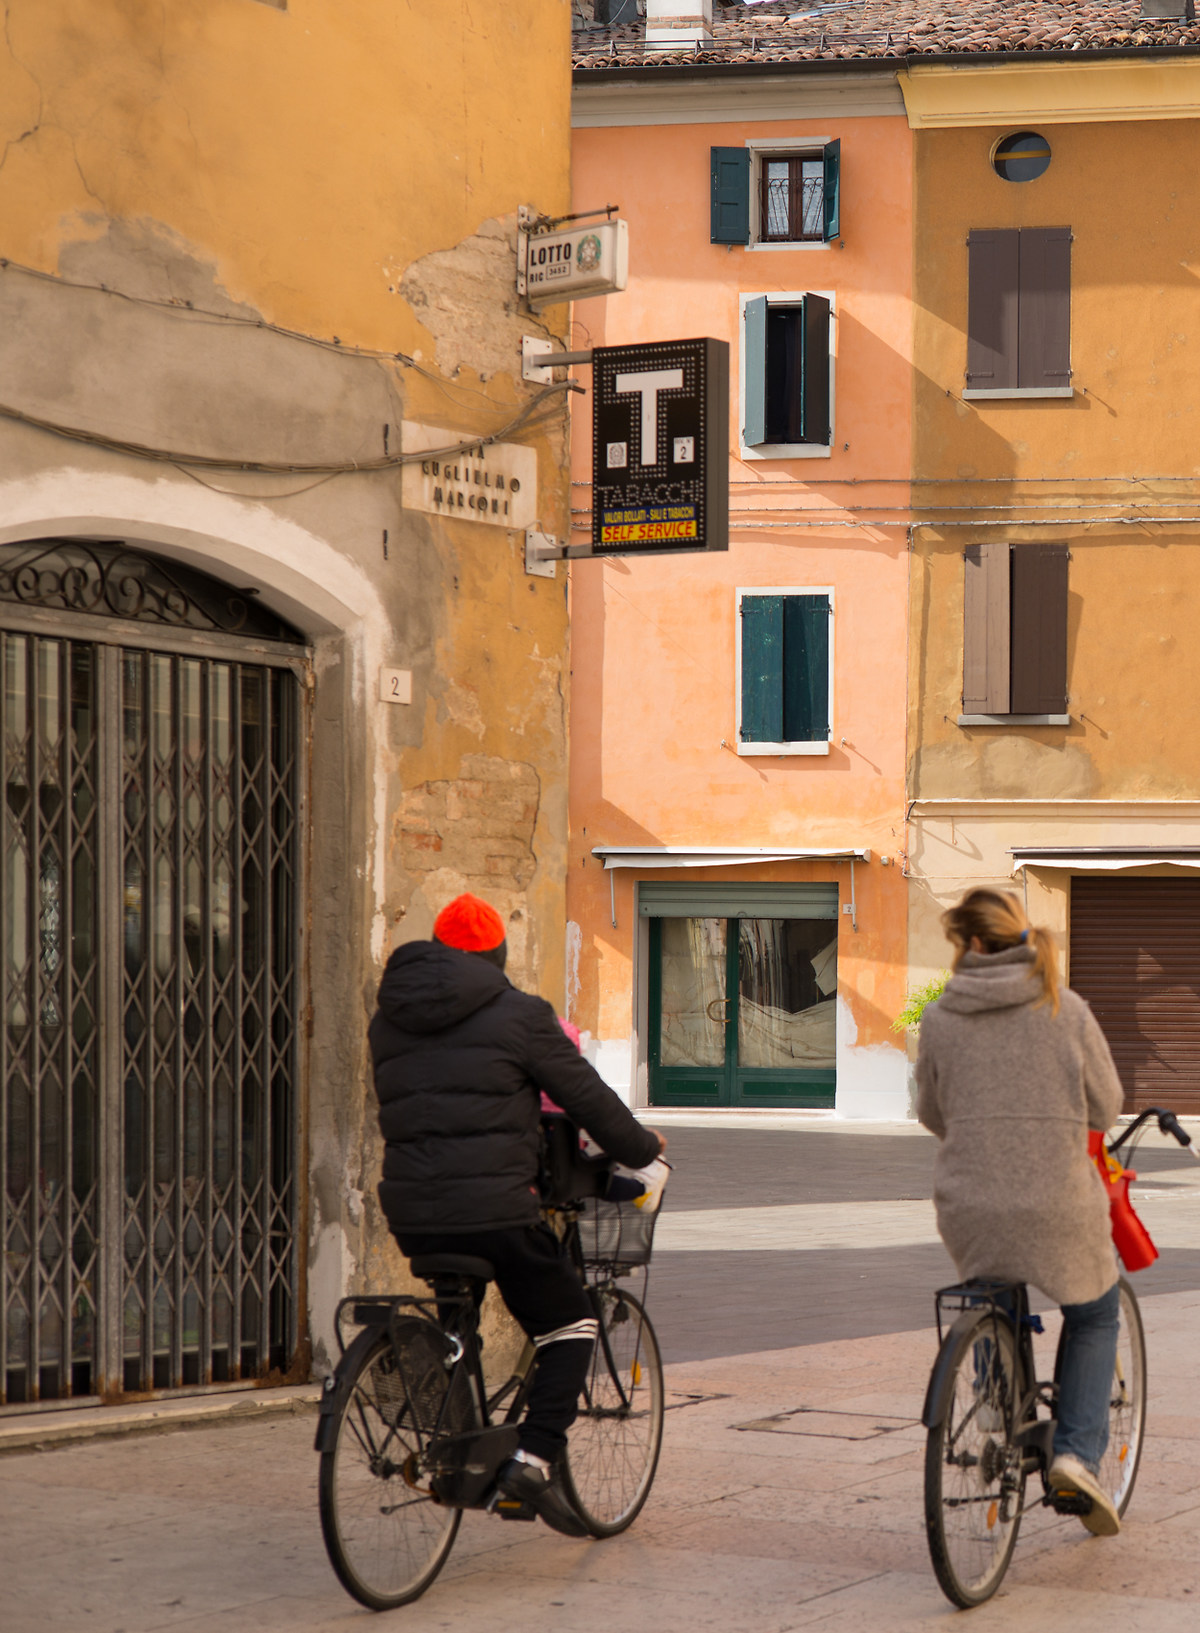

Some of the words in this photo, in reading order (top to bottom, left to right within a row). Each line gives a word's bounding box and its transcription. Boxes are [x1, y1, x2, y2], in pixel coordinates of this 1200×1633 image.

[531, 242, 571, 267] LOTTO
[616, 368, 683, 466] T
[680, 446, 687, 460] 2
[421, 461, 520, 493] GUGLIELMO
[433, 486, 509, 515] MARCONI
[598, 480, 699, 508] TABACCHI
[604, 511, 623, 524] VALORI
[624, 509, 646, 522] BOLLATI
[668, 506, 694, 519] TABACCHI
[604, 525, 634, 541] SELF
[638, 521, 693, 539] SERVICE
[391, 676, 400, 696] 2
